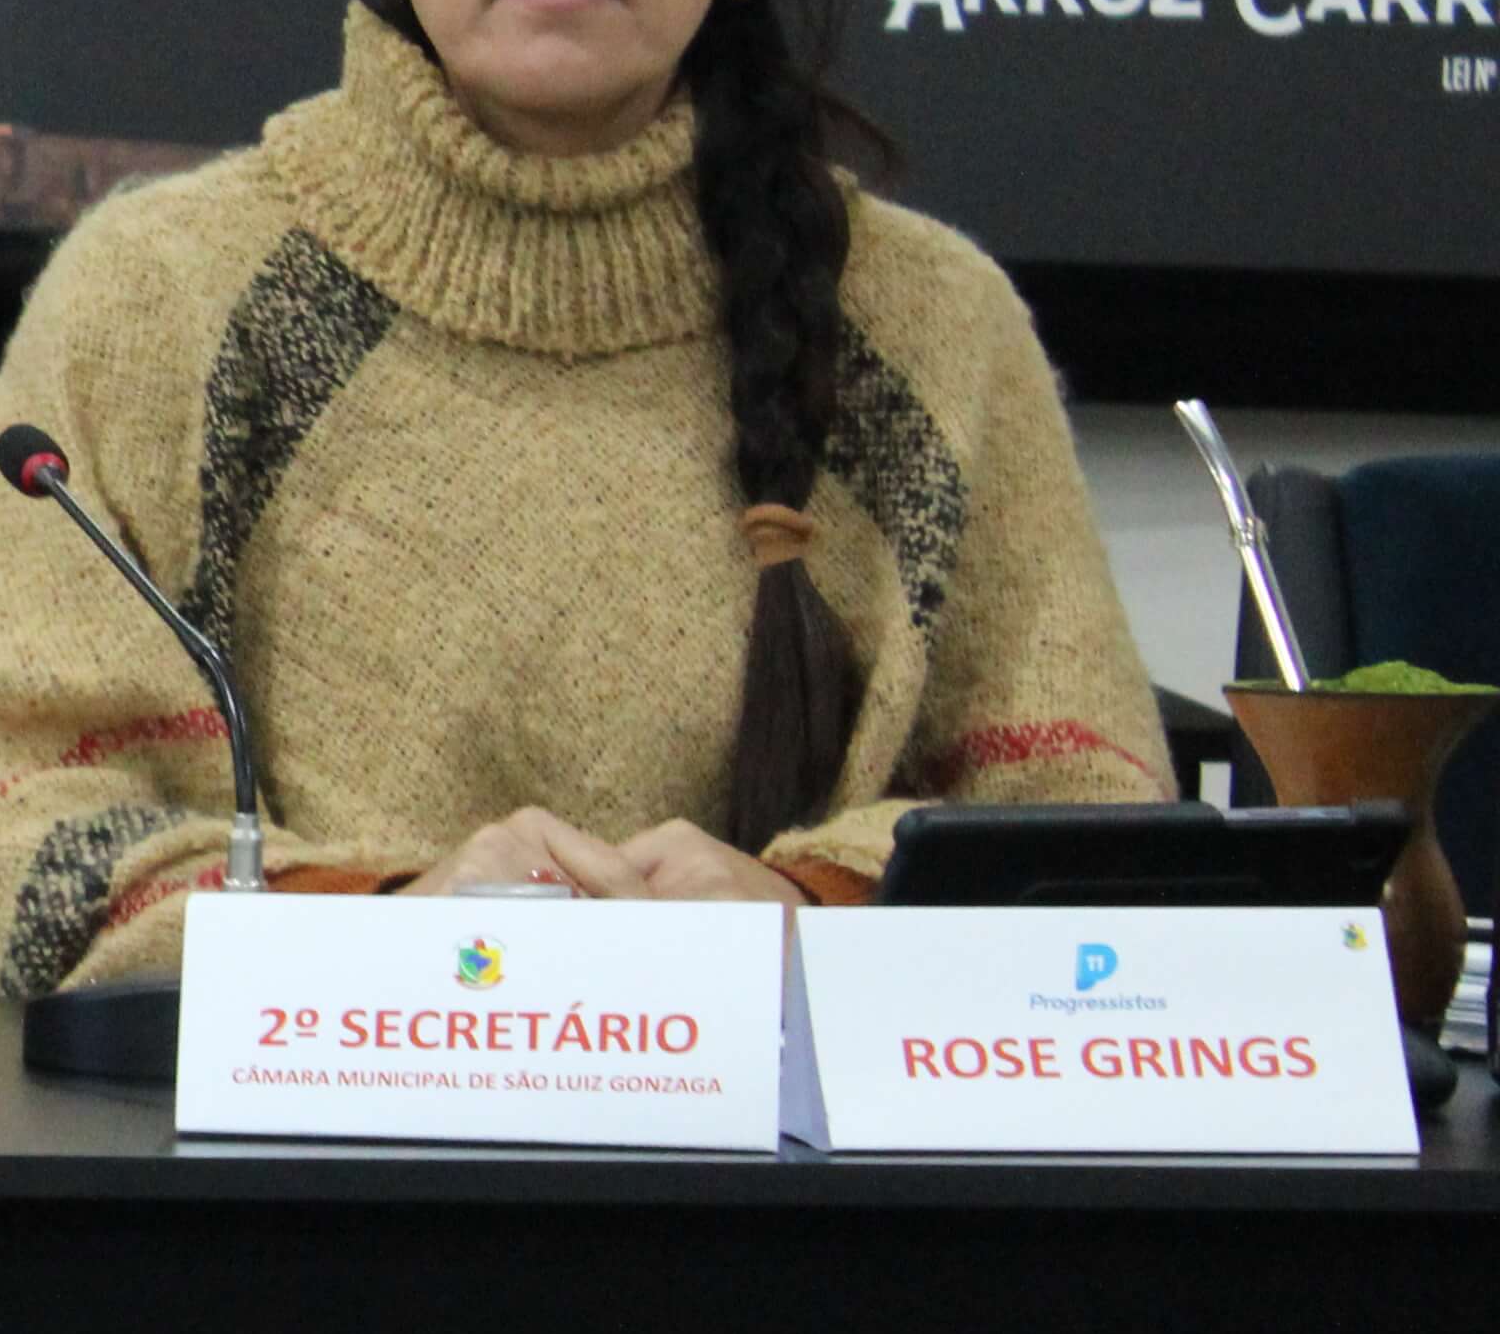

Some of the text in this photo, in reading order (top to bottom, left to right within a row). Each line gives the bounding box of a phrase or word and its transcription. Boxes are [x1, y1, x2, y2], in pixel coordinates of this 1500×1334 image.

[1030, 993, 1168, 1015] Progressistas
[257, 1001, 701, 1055] 2º SECRETÁRIO
[902, 1035, 1319, 1080] ROSE GRINGS
[232, 1067, 724, 1096] CÂMARA MUNICIPAL DE SÃO LUIZ GONZAGA
